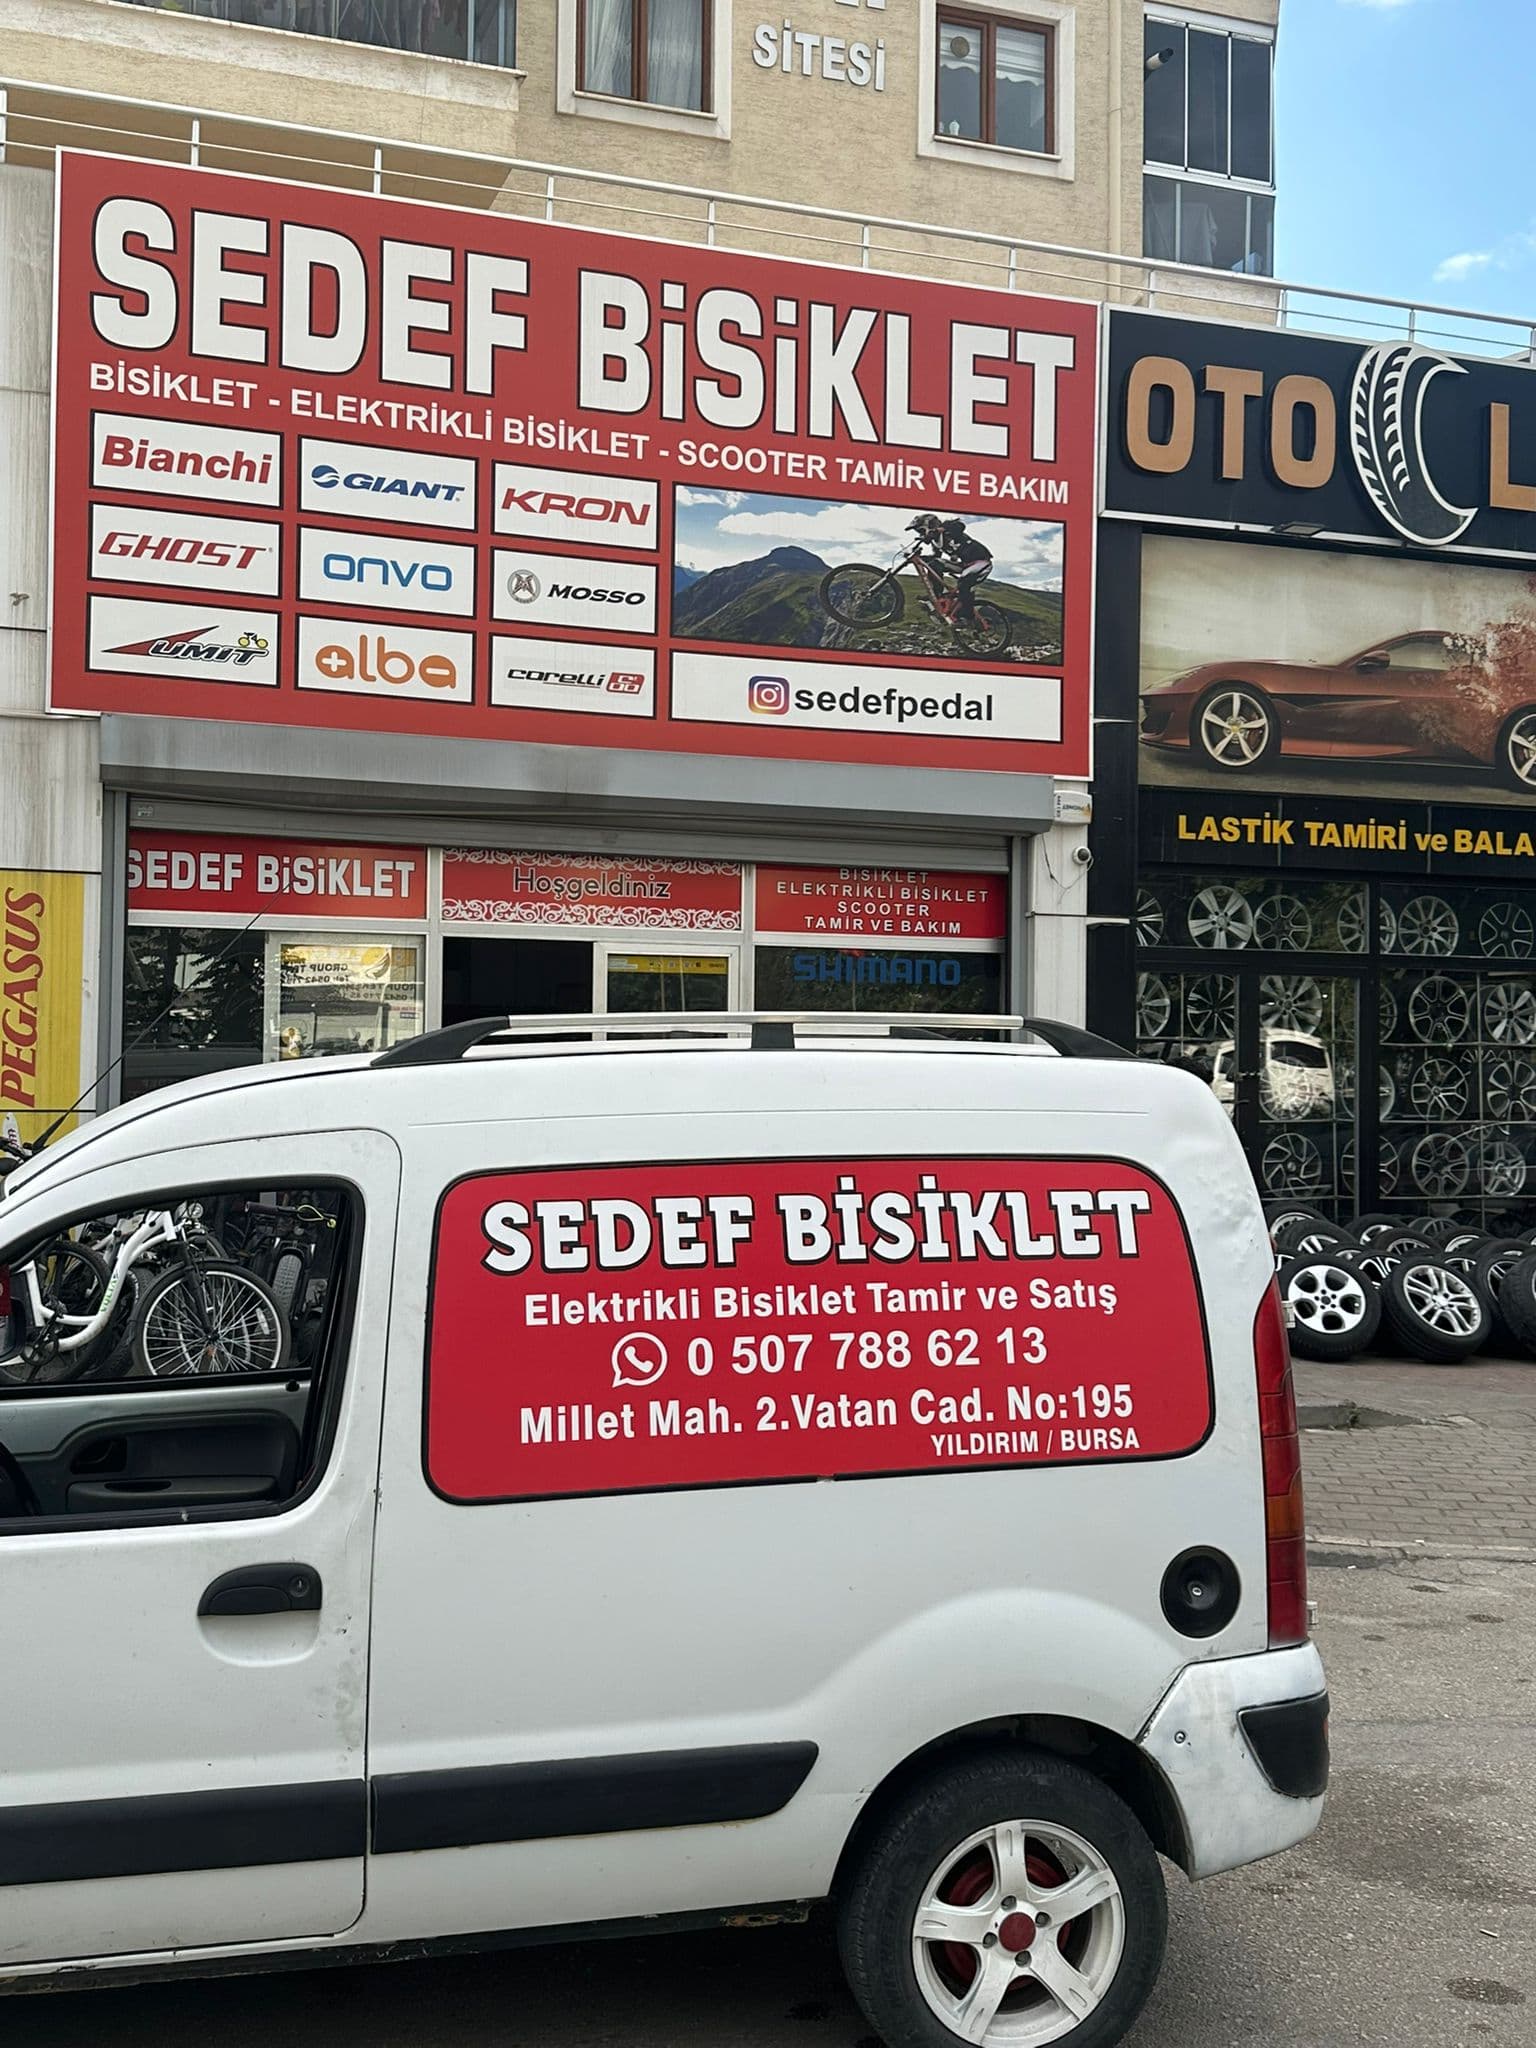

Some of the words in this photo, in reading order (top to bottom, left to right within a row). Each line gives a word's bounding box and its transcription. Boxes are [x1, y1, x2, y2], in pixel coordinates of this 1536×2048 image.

[753, 18, 885, 91] SİTESİ
[92, 196, 530, 396] SEDEF
[89, 360, 258, 409] BİSİKLET
[291, 388, 493, 441] ELEKTRİKLİ
[503, 414, 650, 460] BİSİKLET
[677, 439, 827, 480] SCOOTER
[836, 458, 925, 491] TAMİR
[932, 468, 970, 495] VE
[979, 472, 1069, 505] BAKIM
[1126, 355, 1337, 489] OTO
[101, 434, 273, 485] Bianchi
[342, 472, 466, 502] GIANT
[501, 487, 651, 526] KRON
[98, 530, 268, 570] GHOST
[547, 583, 646, 606] MOSSO
[507, 667, 606, 687] corelli
[794, 685, 994, 723] sedefpedal
[1177, 811, 1295, 845] LASTİK
[1304, 817, 1407, 852] TAMİRİ
[1414, 831, 1449, 853] ve
[128, 848, 244, 893] SEDEF
[513, 866, 672, 902] Hoşgeldiniz
[804, 914, 864, 931] TAMİR
[871, 919, 894, 932] VE
[901, 920, 961, 934] BAKIM
[837, 900, 930, 917] SCOOTER
[793, 951, 962, 986] SHIMANO
[1, 886, 46, 1109] PEGASUS
[481, 1194, 755, 1276] SEDEF
[777, 1174, 1152, 1266] BİSİKLET
[524, 1287, 700, 1327] Elektrikli
[714, 1284, 856, 1319] Bisiklet
[866, 1280, 966, 1313] Tamir
[977, 1286, 1018, 1311] ve
[1029, 1278, 1118, 1315] Satış
[687, 1336, 714, 1377] 0
[731, 1333, 813, 1375] 507
[829, 1330, 912, 1370] 788
[927, 1329, 980, 1367] 62
[997, 1326, 1048, 1365] 13
[520, 1404, 635, 1444] Millet
[649, 1398, 742, 1437] Mah.
[756, 1393, 897, 1432] 2.Vatan
[910, 1387, 994, 1425] Cad.
[1008, 1384, 1134, 1422] No:195
[931, 1430, 1039, 1457] YILDIRIM
[1060, 1427, 1140, 1452] BURSA
